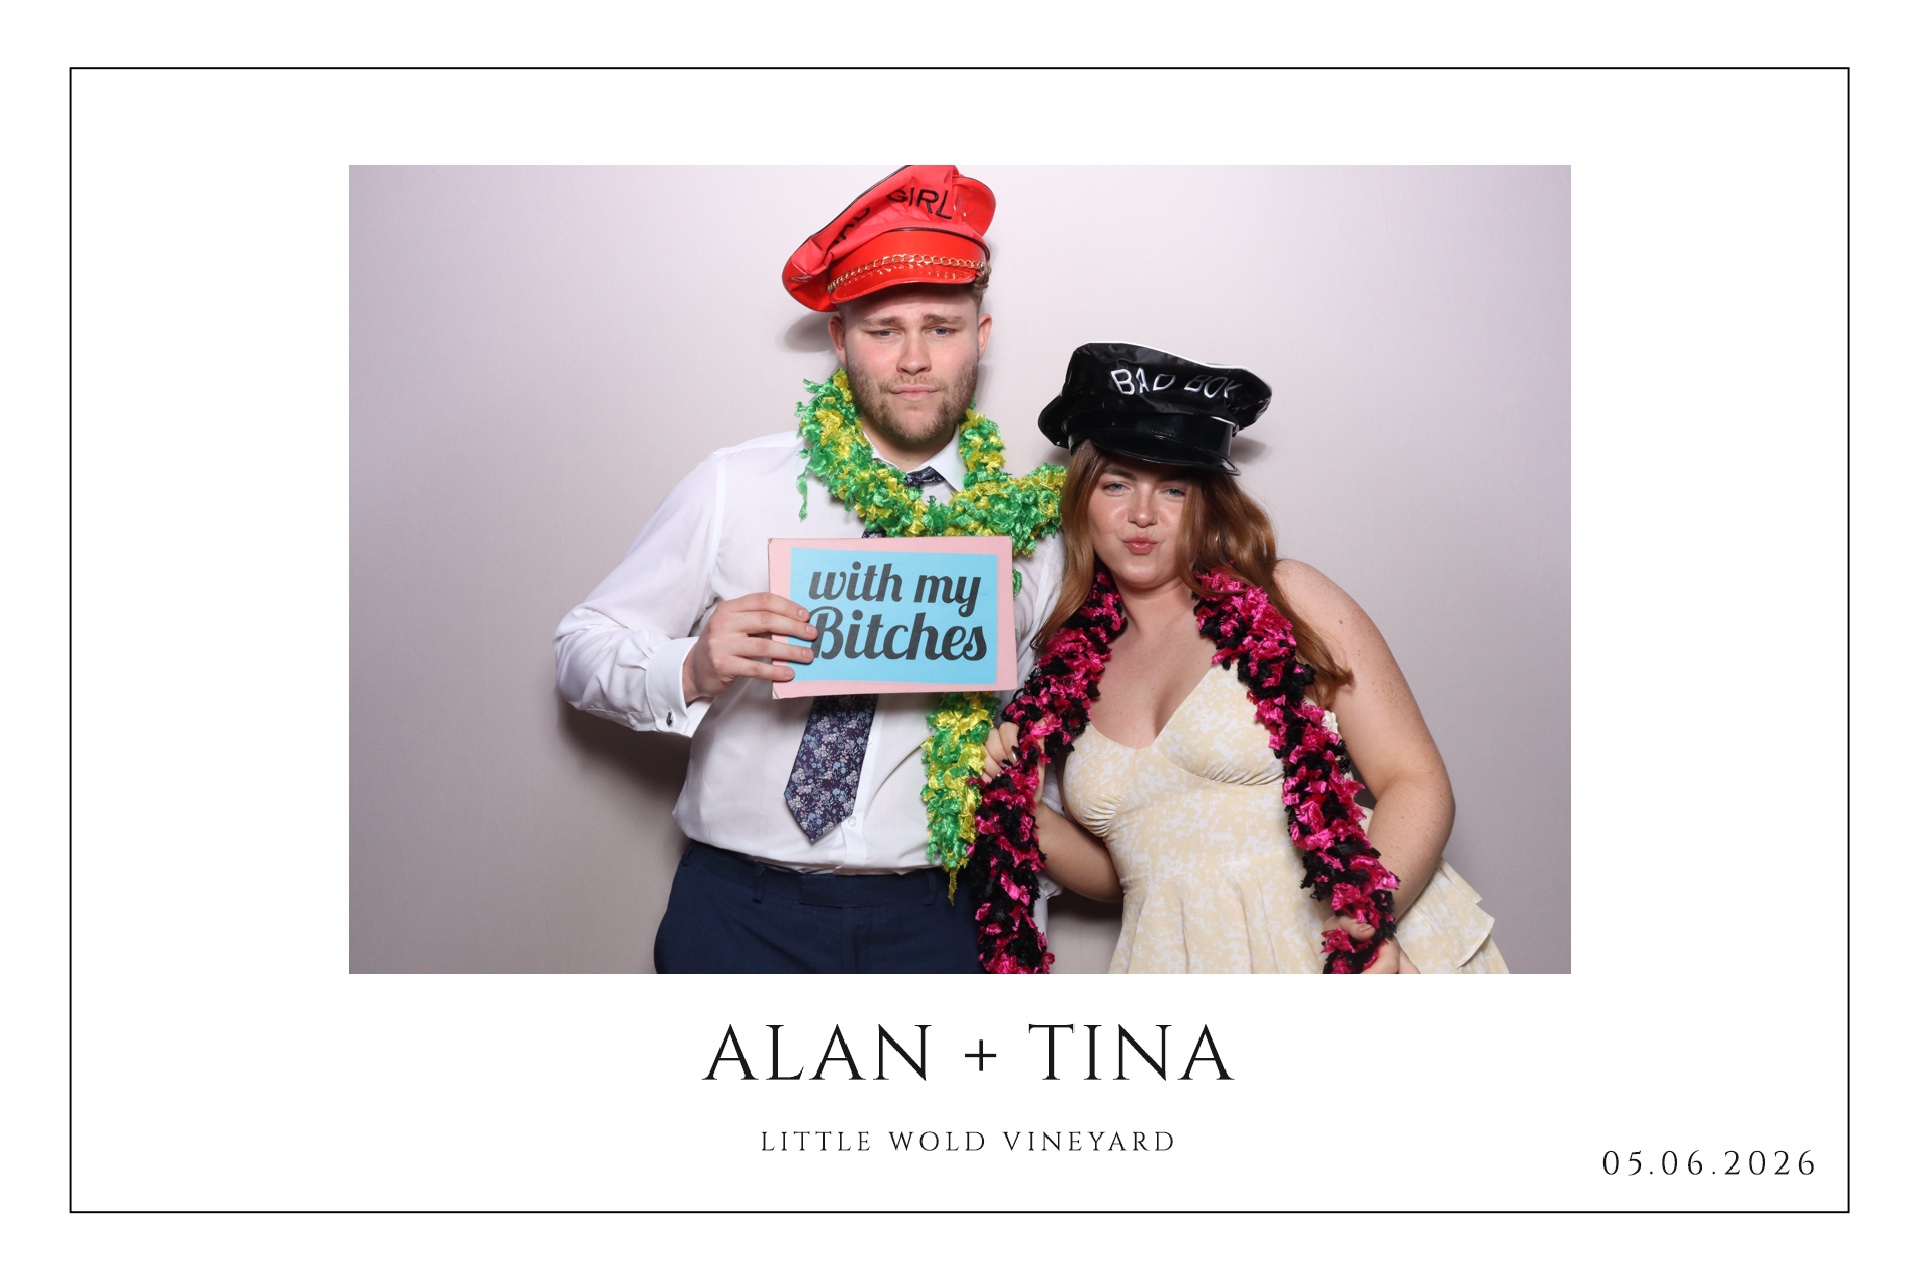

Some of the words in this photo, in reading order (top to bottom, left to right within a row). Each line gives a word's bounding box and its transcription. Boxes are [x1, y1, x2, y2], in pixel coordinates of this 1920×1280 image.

[886, 186, 954, 220] GIRL
[1110, 367, 1177, 396] BAD
[808, 561, 903, 603] with
[913, 574, 982, 618] my
[808, 605, 988, 662] Bitches
